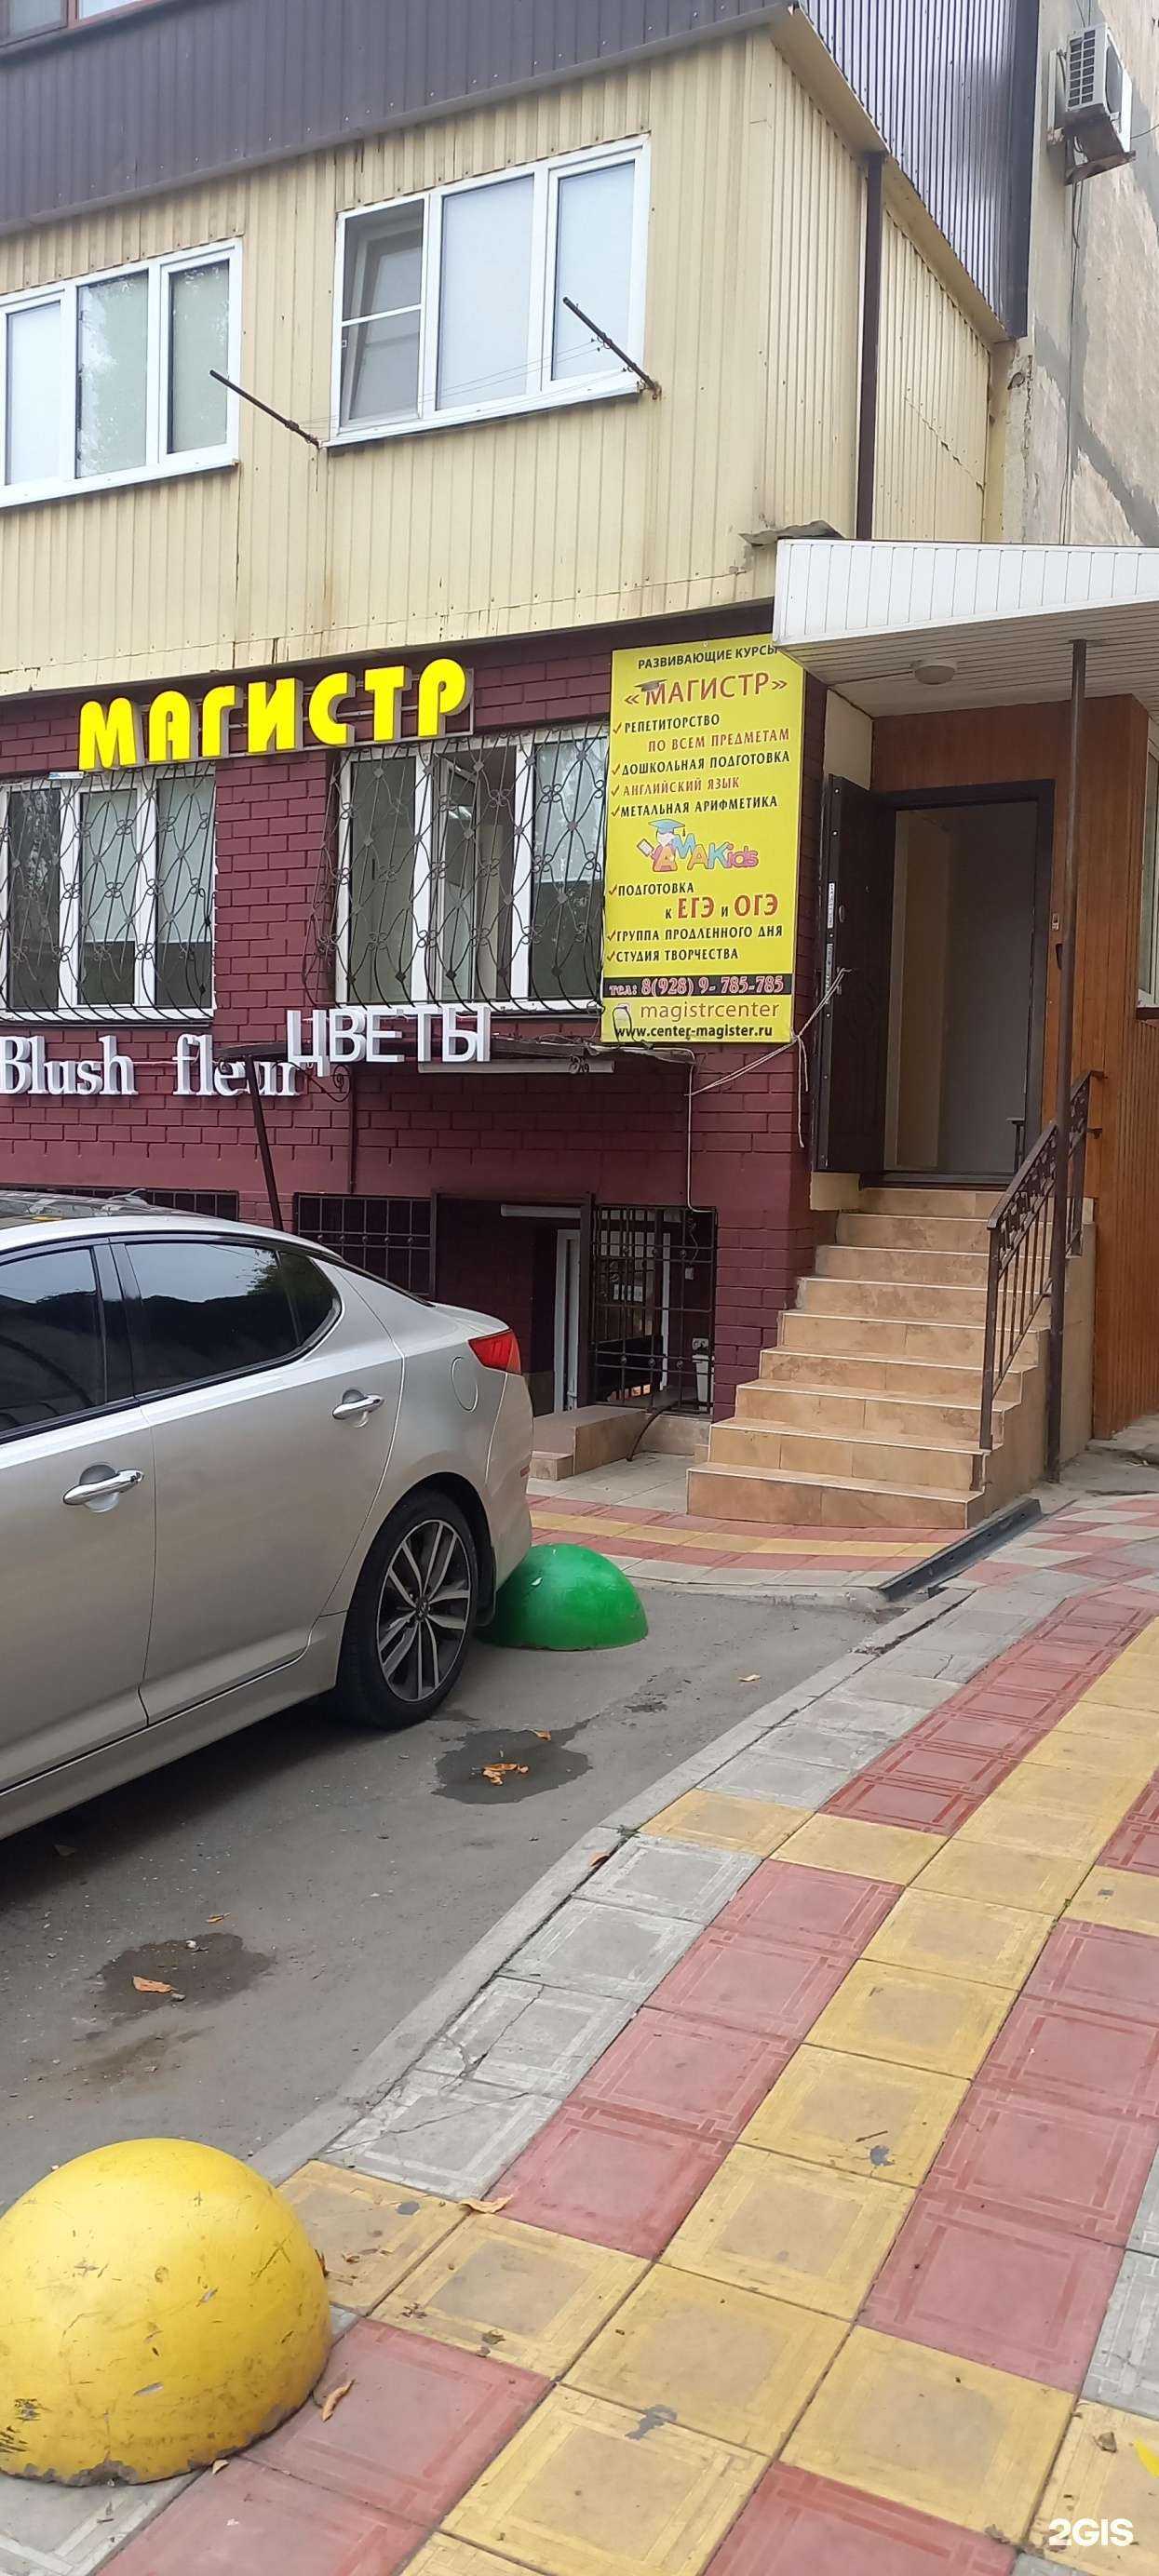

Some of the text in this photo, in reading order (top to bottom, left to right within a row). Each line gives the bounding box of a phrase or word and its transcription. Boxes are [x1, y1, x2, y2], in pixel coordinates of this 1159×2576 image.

[639, 650, 732, 669] РАЗВИВАЮЩИЕ
[78, 658, 472, 771] МАГИСТР
[625, 714, 720, 733] РЕПЕТИТОРСТВО
[648, 729, 789, 752] ПО ВСЕМ ПРЕДМЕТАМ
[622, 751, 789, 775] ДОШКОЛЬНАЯ ПОДГОТОВКА
[623, 777, 739, 796] АНГЛИЙСКИЙ ЯЗЫК
[620, 796, 777, 817] МЕТАЛЬНАЯ АРИФМЕТИКА
[618, 882, 694, 896] ПОДГОТОВКА
[678, 896, 714, 919] ЕГЭ
[734, 894, 778, 916] ОГЭ
[616, 926, 783, 942] ГРУППА ПРОДЛЕННОГО ДНЯ
[616, 948, 738, 962] СТУДИЯ ТВОРЧЕСТВА
[641, 978, 694, 996] 8(928)
[721, 976, 784, 993] 785-785
[640, 1001, 779, 1022] magistrcenter
[287, 1006, 492, 1077] ЦВЕТЫ
[614, 1025, 773, 1039] www.center-magister.ru
[0, 1034, 305, 1096] Blush fleur
